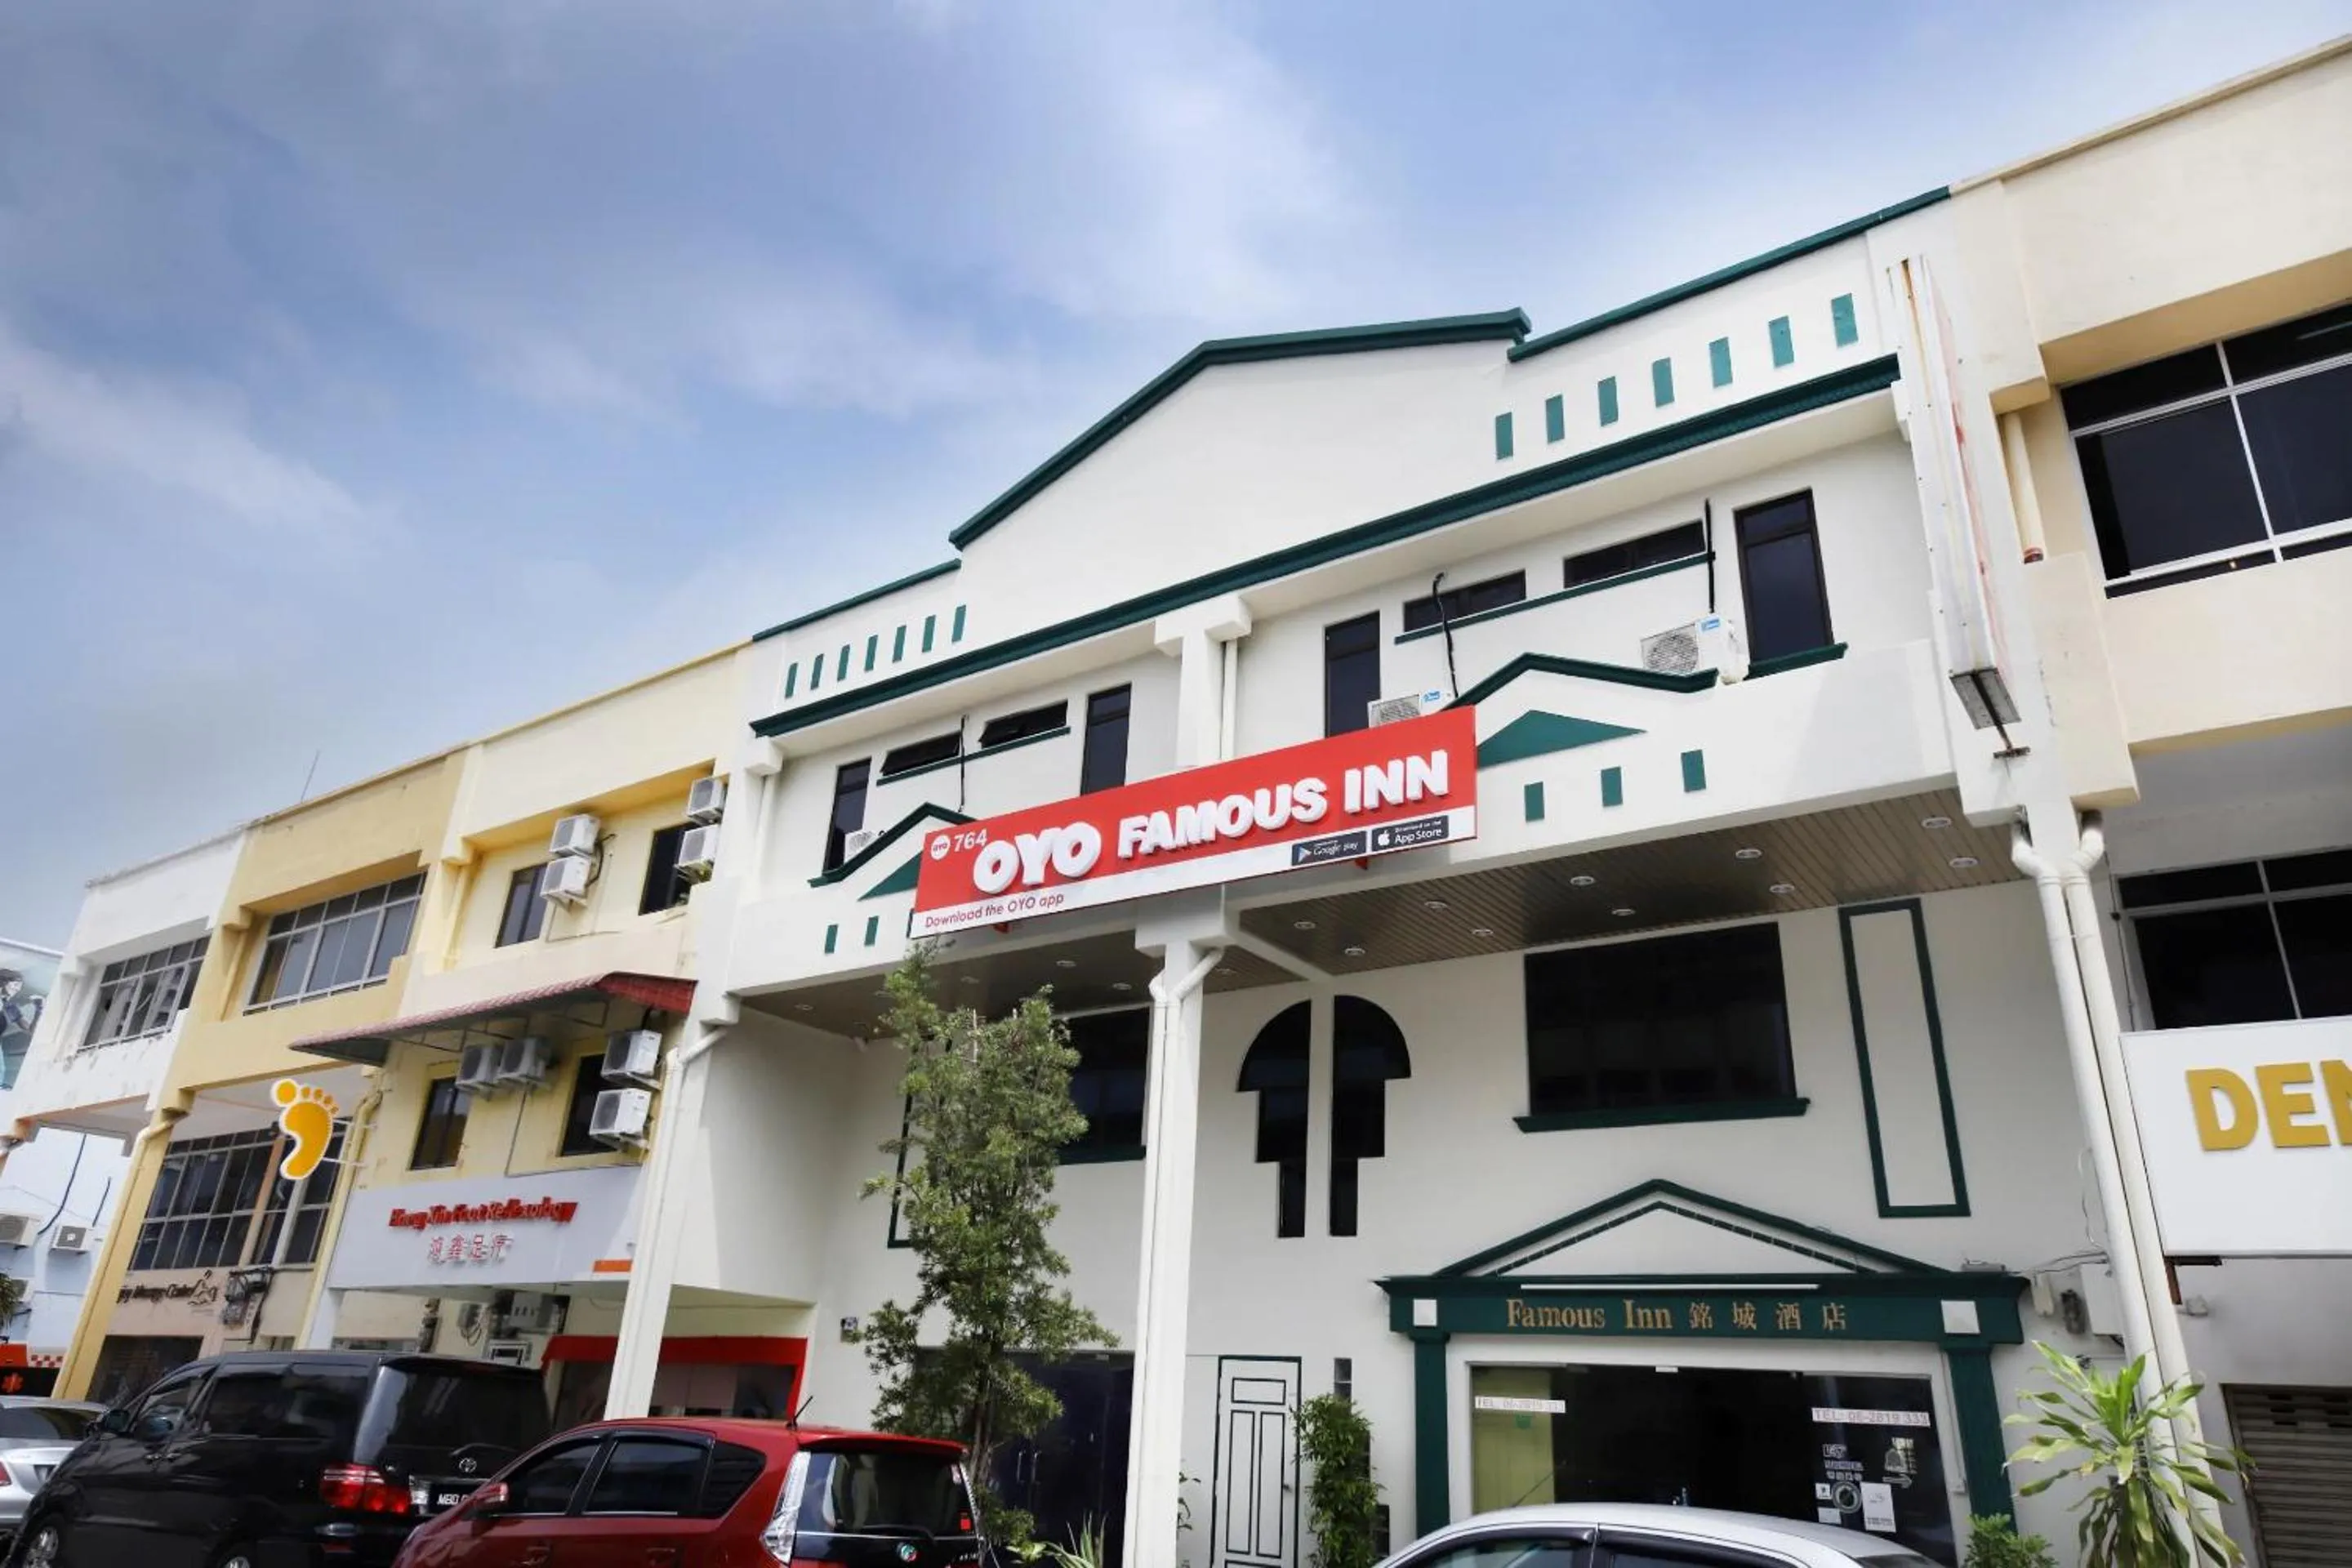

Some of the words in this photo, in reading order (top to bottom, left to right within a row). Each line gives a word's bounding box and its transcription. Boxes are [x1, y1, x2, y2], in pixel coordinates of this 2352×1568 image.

[973, 822, 1102, 894] OYO
[1117, 777, 1329, 858] FAMOUS
[1344, 750, 1449, 813] INN
[1395, 833, 1414, 844] App
[1416, 828, 1442, 840] Store
[954, 830, 987, 853] 764
[925, 906, 982, 928] Download
[986, 903, 1004, 916] the
[1008, 896, 1036, 913] OYO
[1040, 893, 1064, 907] app
[1506, 1298, 1606, 1329] Famous
[1623, 1298, 1673, 1330] Inn
